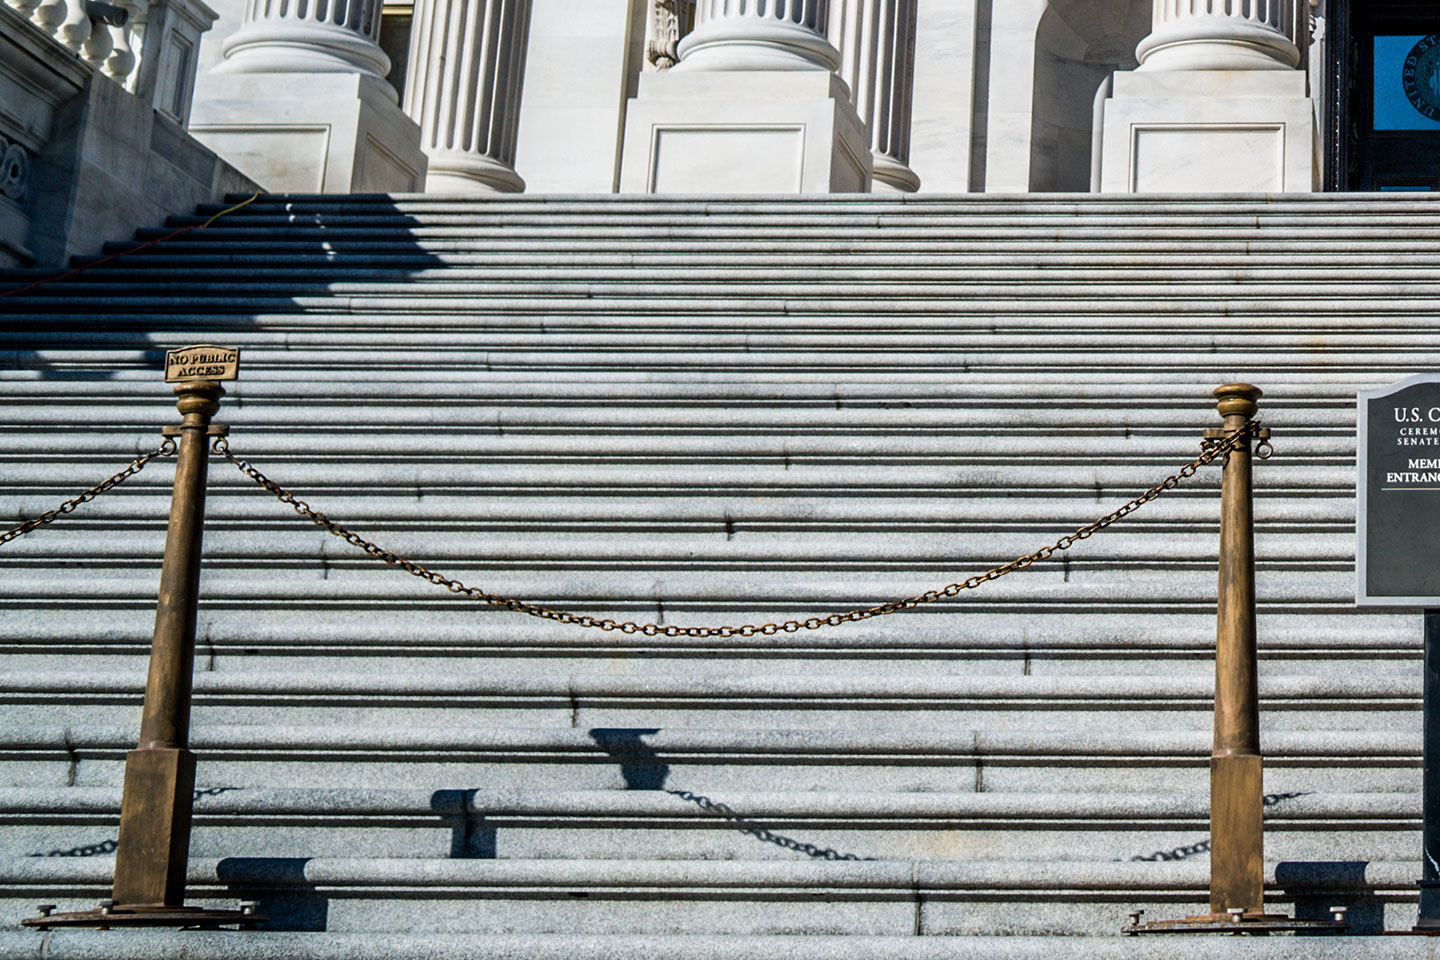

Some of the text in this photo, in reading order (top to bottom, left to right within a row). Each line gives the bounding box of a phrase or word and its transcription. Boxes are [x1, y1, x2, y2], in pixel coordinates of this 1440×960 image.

[1404, 55, 1434, 117] UNITED
[169, 353, 236, 366] NO PUBLIC
[177, 365, 225, 377] ACCESS
[1394, 407, 1423, 422] U.S.
